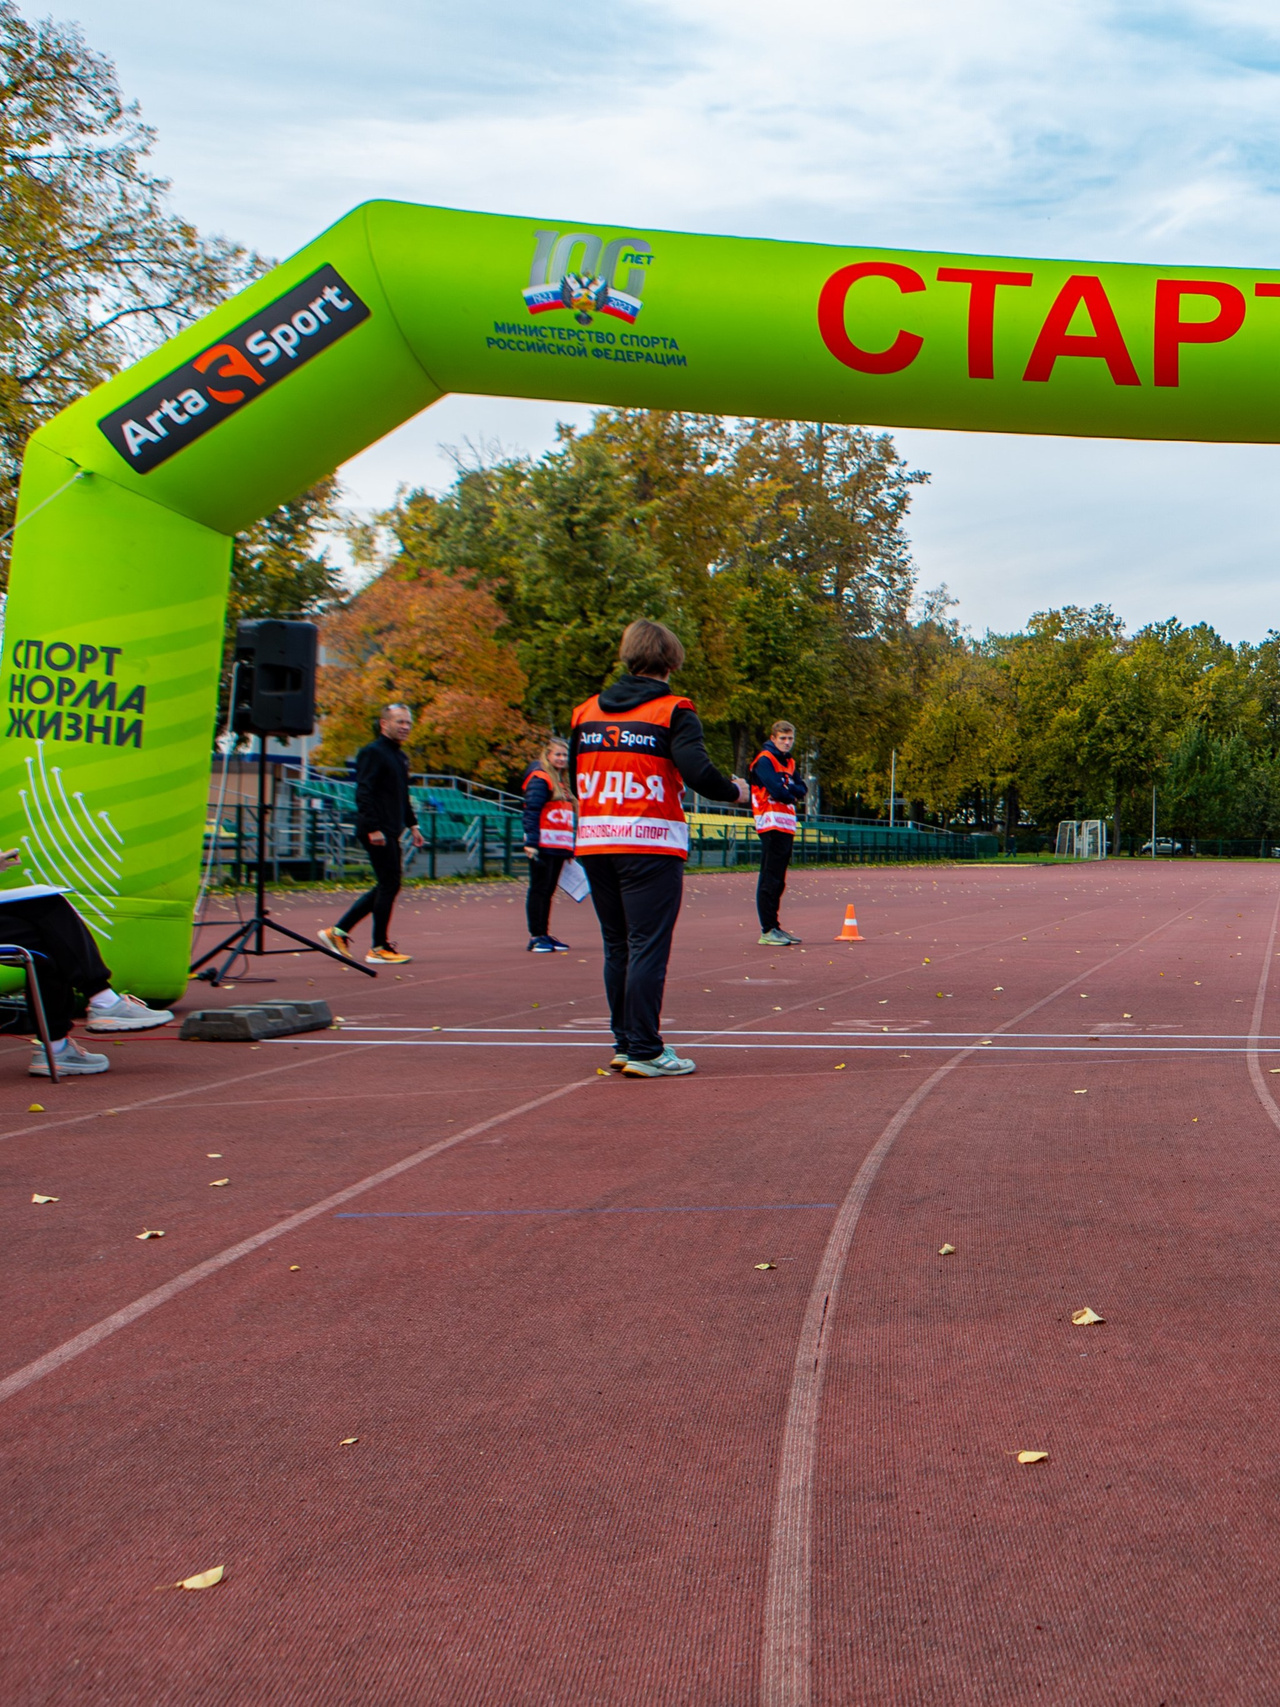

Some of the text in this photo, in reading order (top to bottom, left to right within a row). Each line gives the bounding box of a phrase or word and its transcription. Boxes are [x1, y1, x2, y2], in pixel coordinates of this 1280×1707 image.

[622, 252, 655, 265] ЛЕТ
[486, 336, 688, 367] РОССИЙСКОЙ ФЕДЕРАЦИИ
[493, 321, 680, 351] МИНИСТЕРСТВО СПОРТА
[121, 285, 353, 456] Arta Sport
[13, 639, 122, 676] СПОРТ
[8, 673, 147, 714] НОРМА
[5, 707, 143, 749] ЖИЗНИ
[580, 731, 657, 747] Arta Sport
[635, 825, 669, 840] СПОРТ
